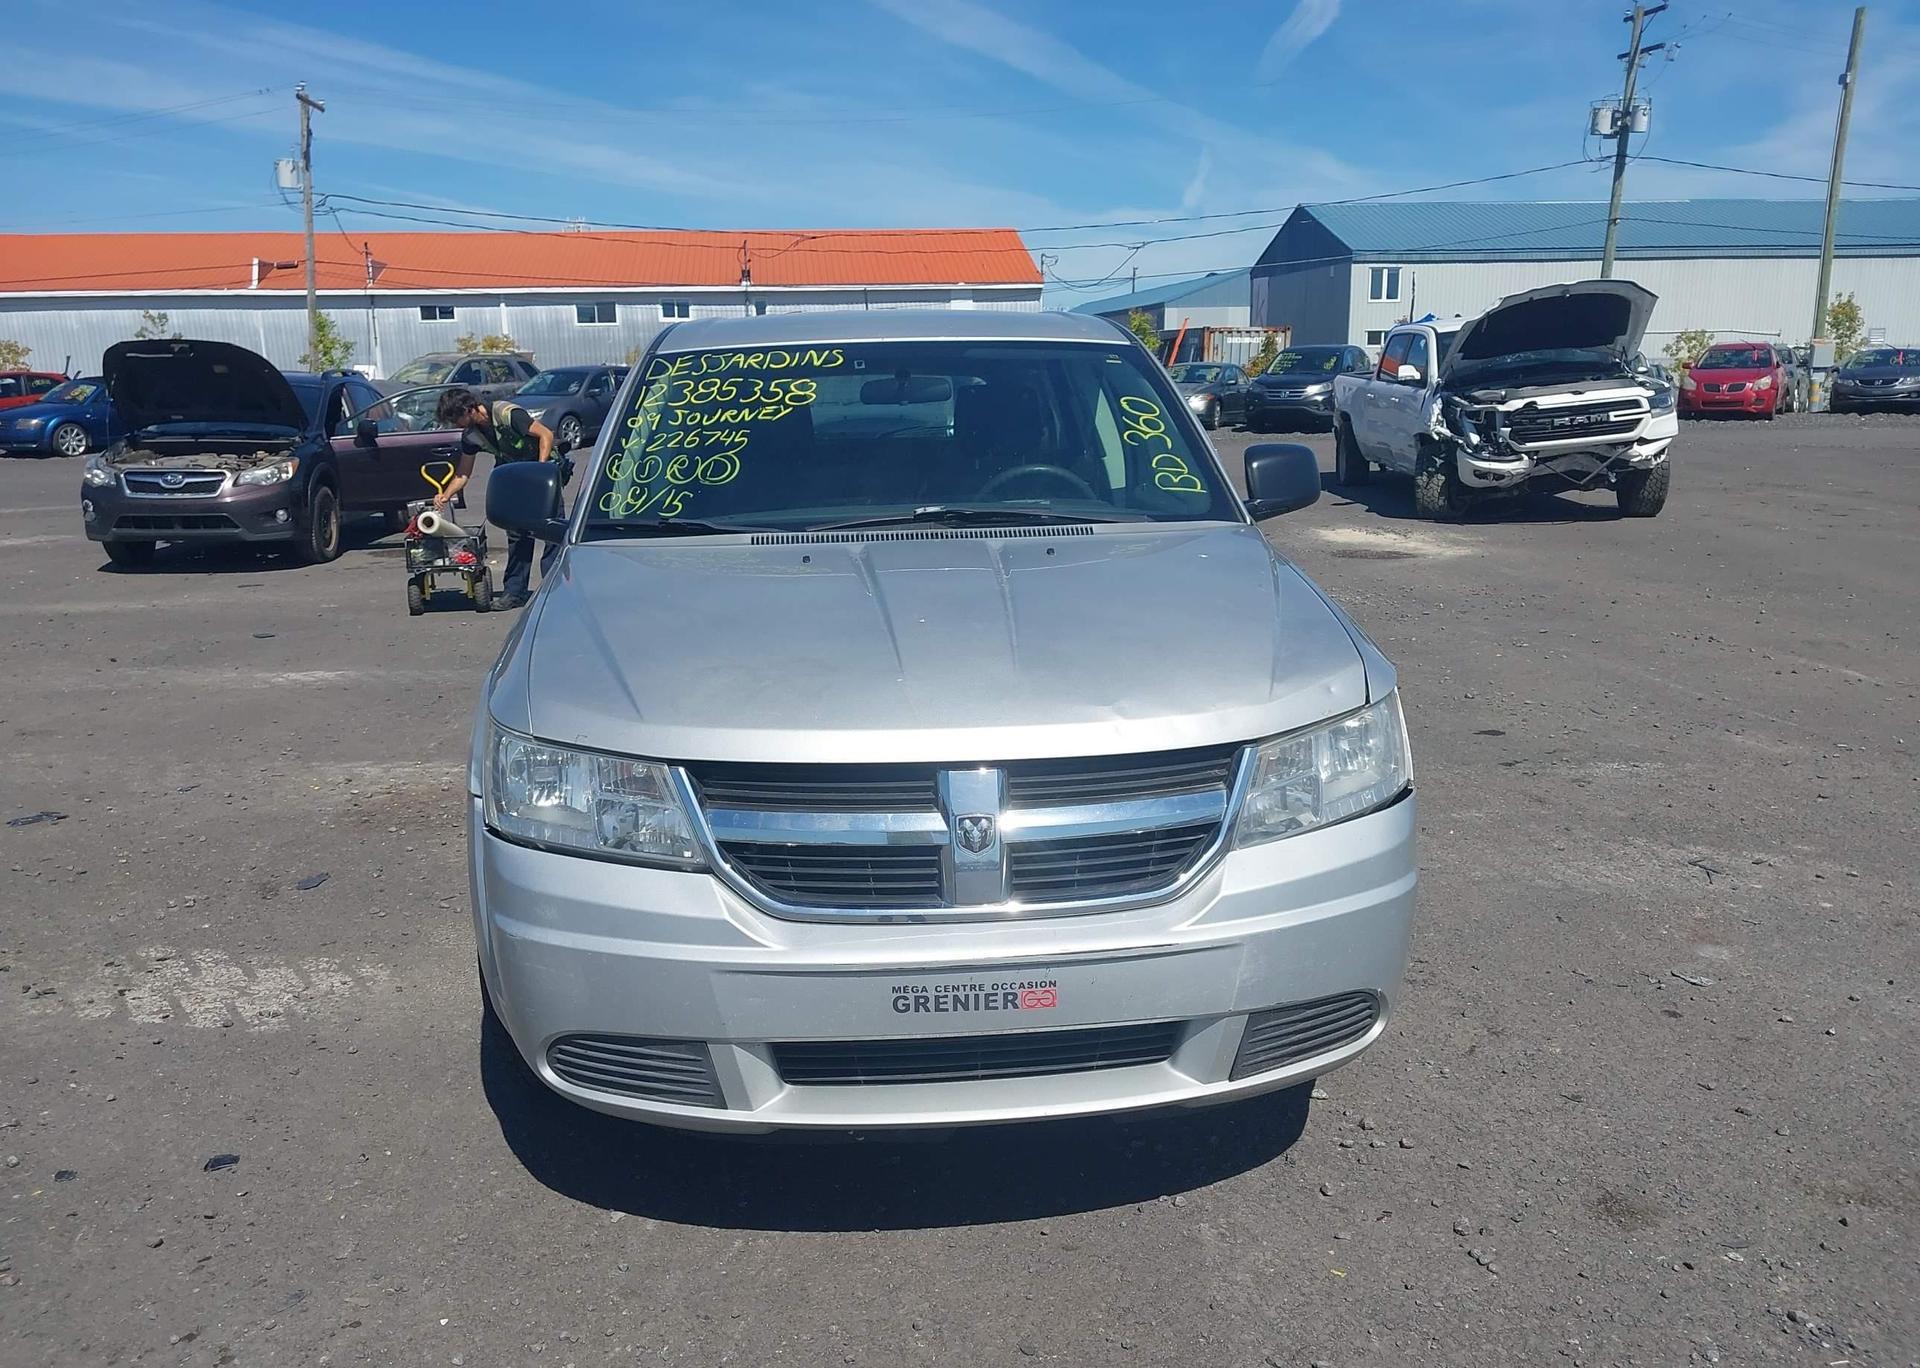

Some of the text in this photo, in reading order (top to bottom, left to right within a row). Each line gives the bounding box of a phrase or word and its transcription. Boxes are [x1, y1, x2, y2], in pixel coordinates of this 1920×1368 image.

[645, 349, 844, 381] DESJARDINS
[668, 405, 793, 426] JOURNEY
[1120, 396, 1172, 450] 360
[1553, 413, 1609, 427] RAM
[934, 984, 985, 993] CENTRE
[991, 980, 1057, 991] OCCASION
[892, 991, 1019, 1014] GRENIER
